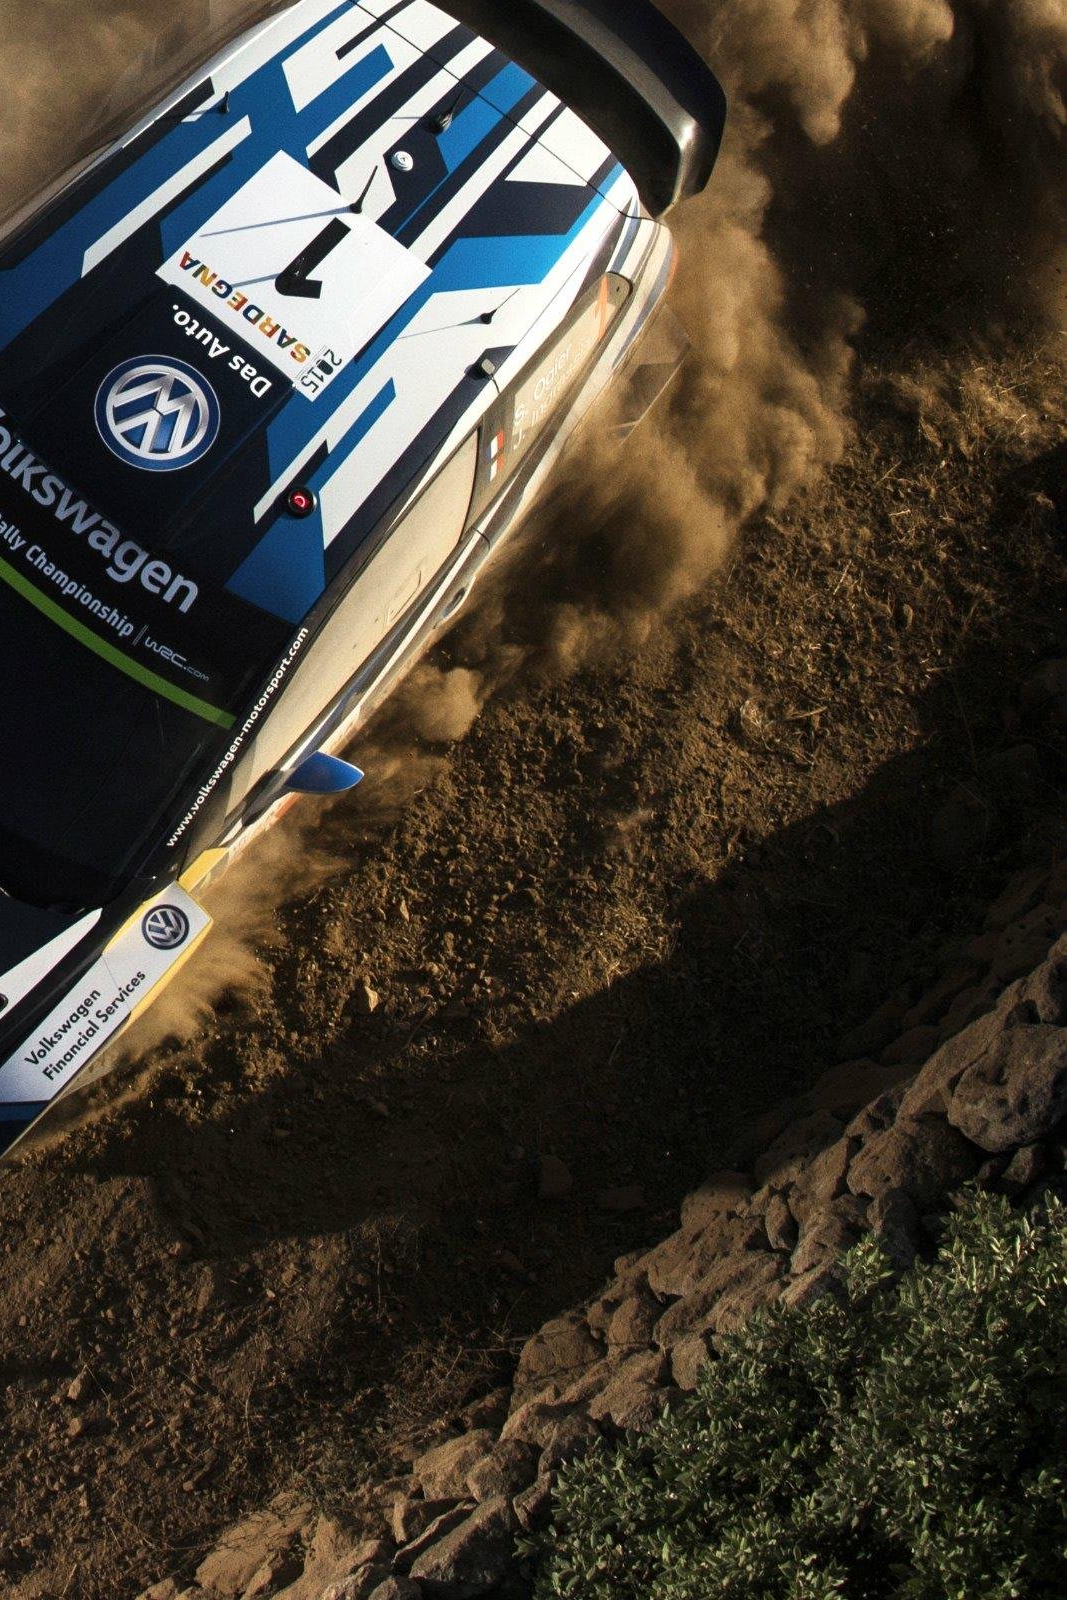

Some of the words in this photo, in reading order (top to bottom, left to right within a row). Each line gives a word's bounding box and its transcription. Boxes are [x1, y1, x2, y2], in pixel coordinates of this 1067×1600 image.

[275, 217, 352, 299] 1
[172, 303, 231, 359] Auto.
[178, 250, 312, 364] SARDEGNA
[228, 353, 273, 399] Das
[300, 348, 343, 394] 2015
[25, 544, 135, 639] Championship
[166, 626, 309, 848] www.volkswagen-motorsport.com
[23, 988, 102, 1067] Volkswagen
[41, 1019, 101, 1081] Financial
[95, 970, 146, 1023] Services
